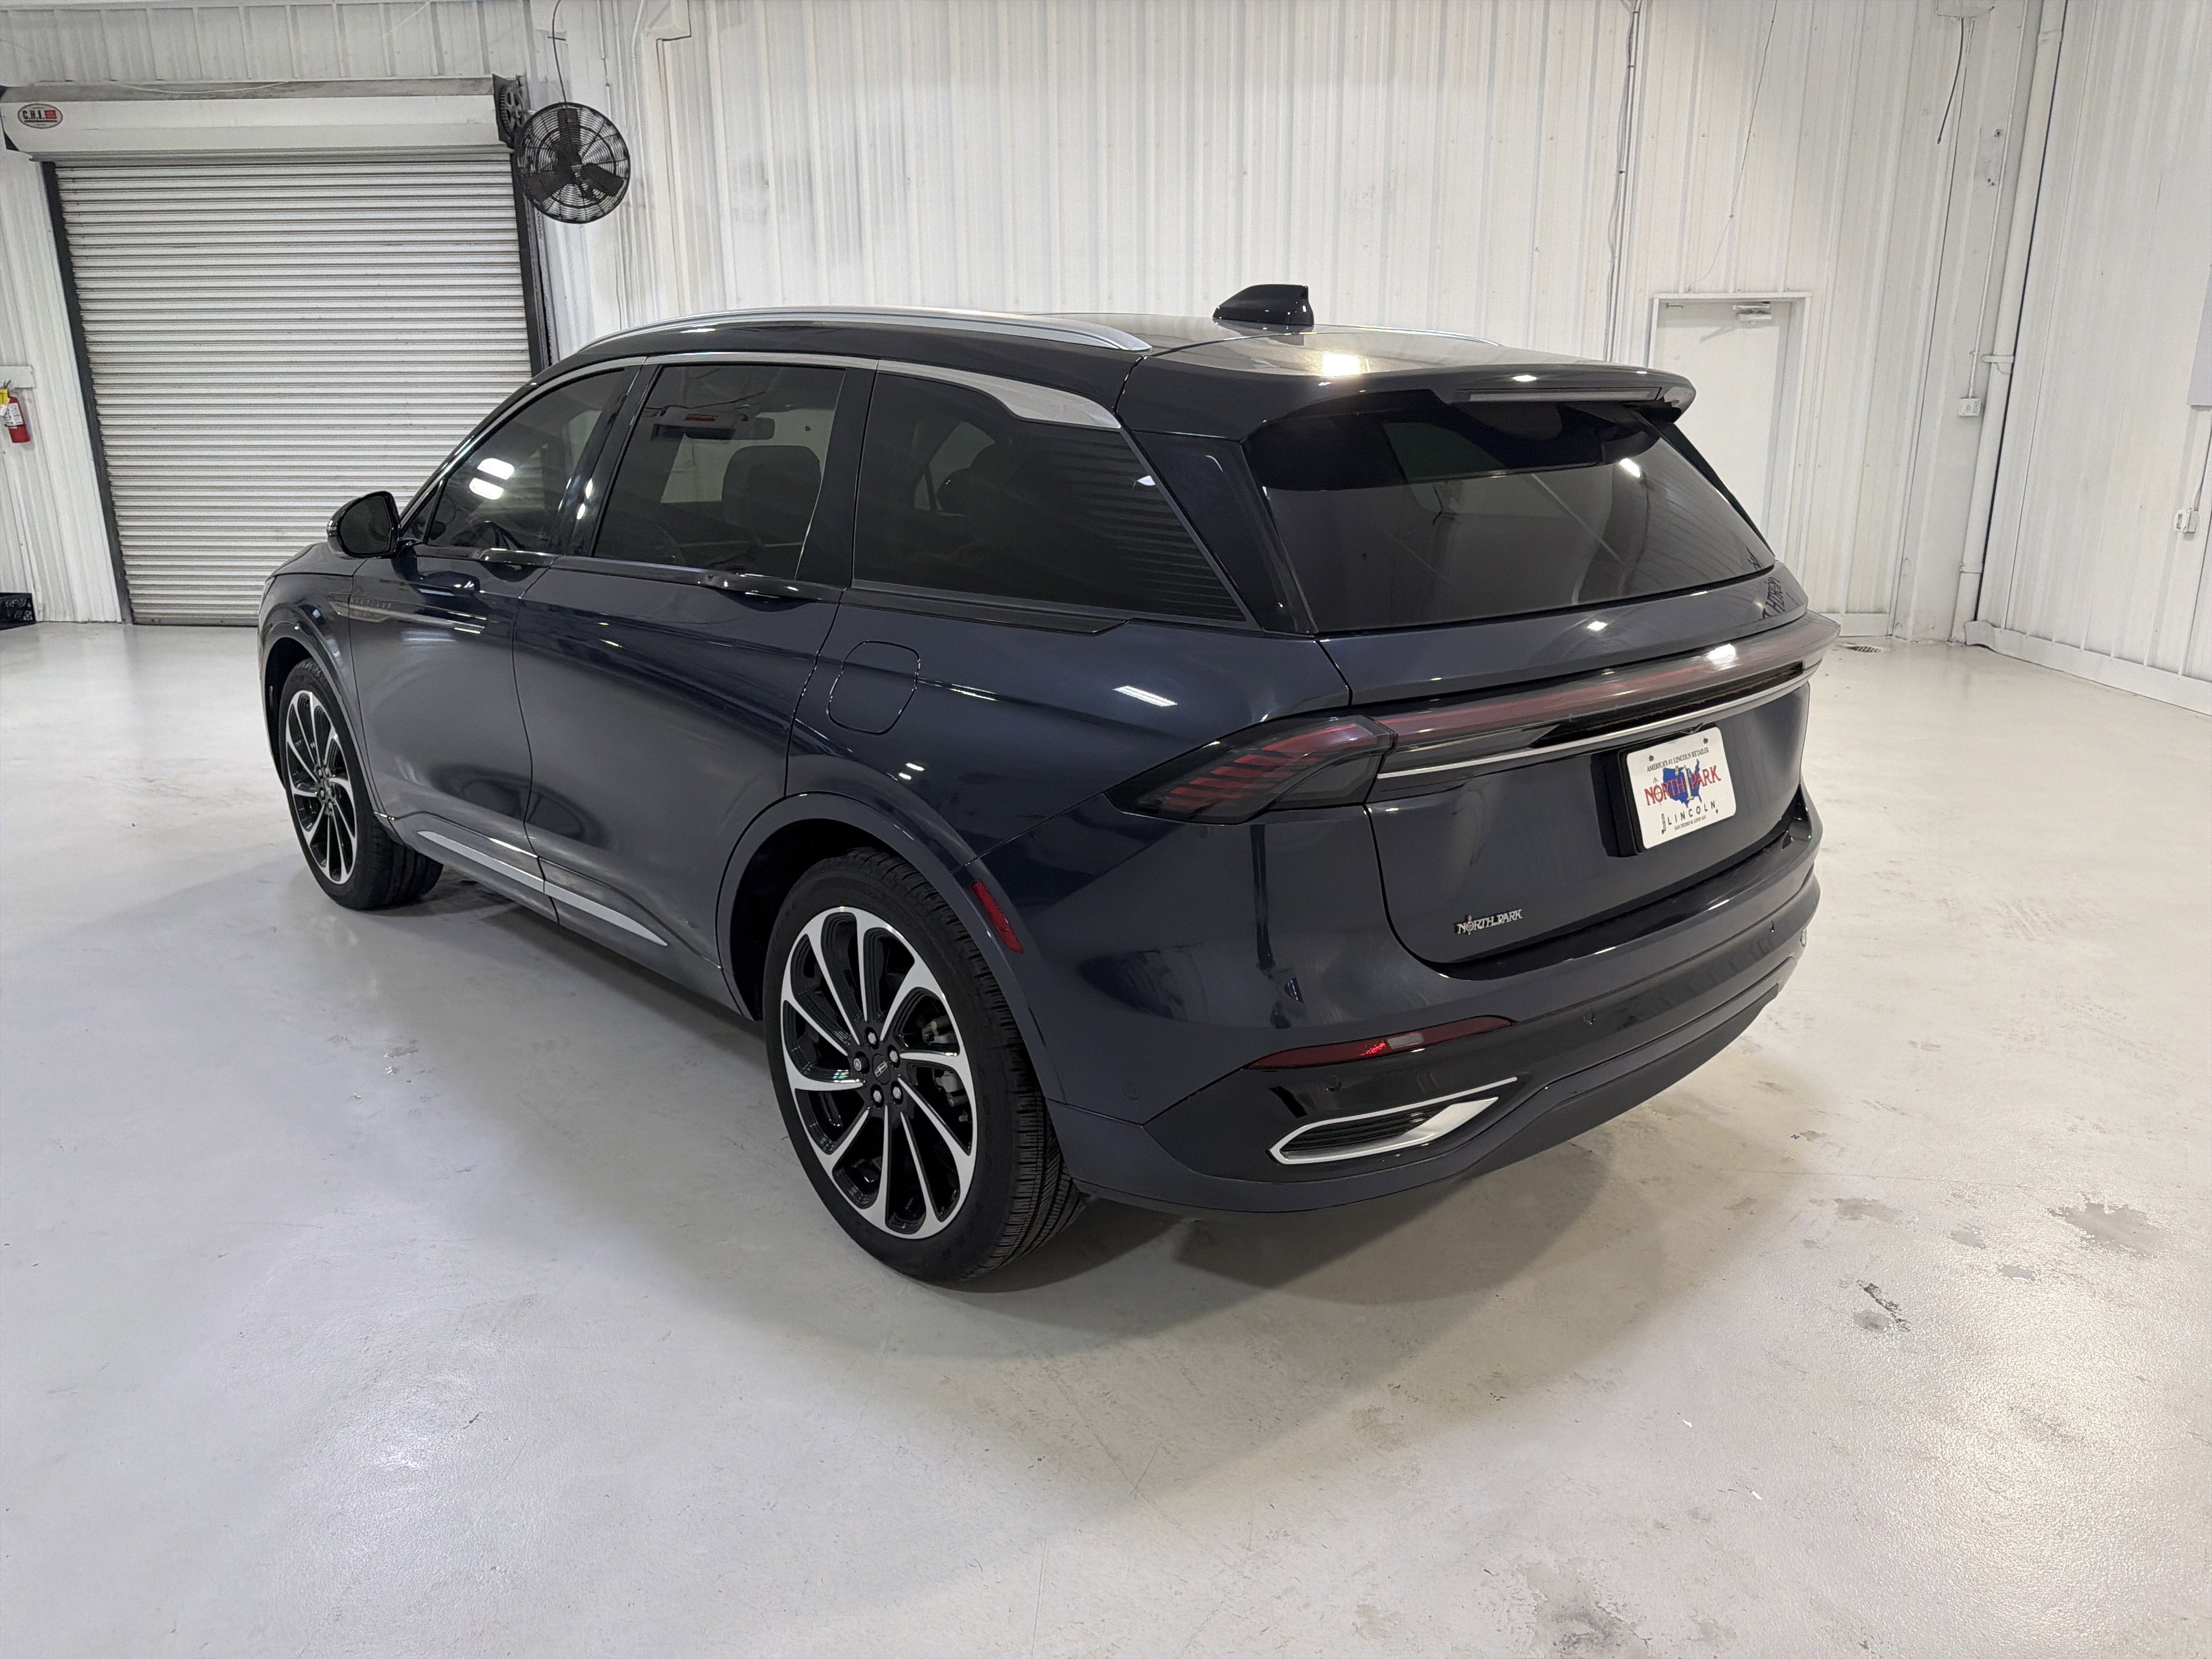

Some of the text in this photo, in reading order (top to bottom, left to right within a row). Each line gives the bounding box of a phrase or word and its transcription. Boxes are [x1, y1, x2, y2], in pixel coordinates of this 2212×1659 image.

[1646, 759, 1668, 772] AMERICA'S
[1673, 752, 1692, 764] LINCOLN
[1691, 747, 1709, 758] RETAILER
[1644, 765, 1722, 806] NORTH PARK
[1667, 800, 1716, 826] LINCOLN
[1457, 909, 1523, 935] NORTH PARK
